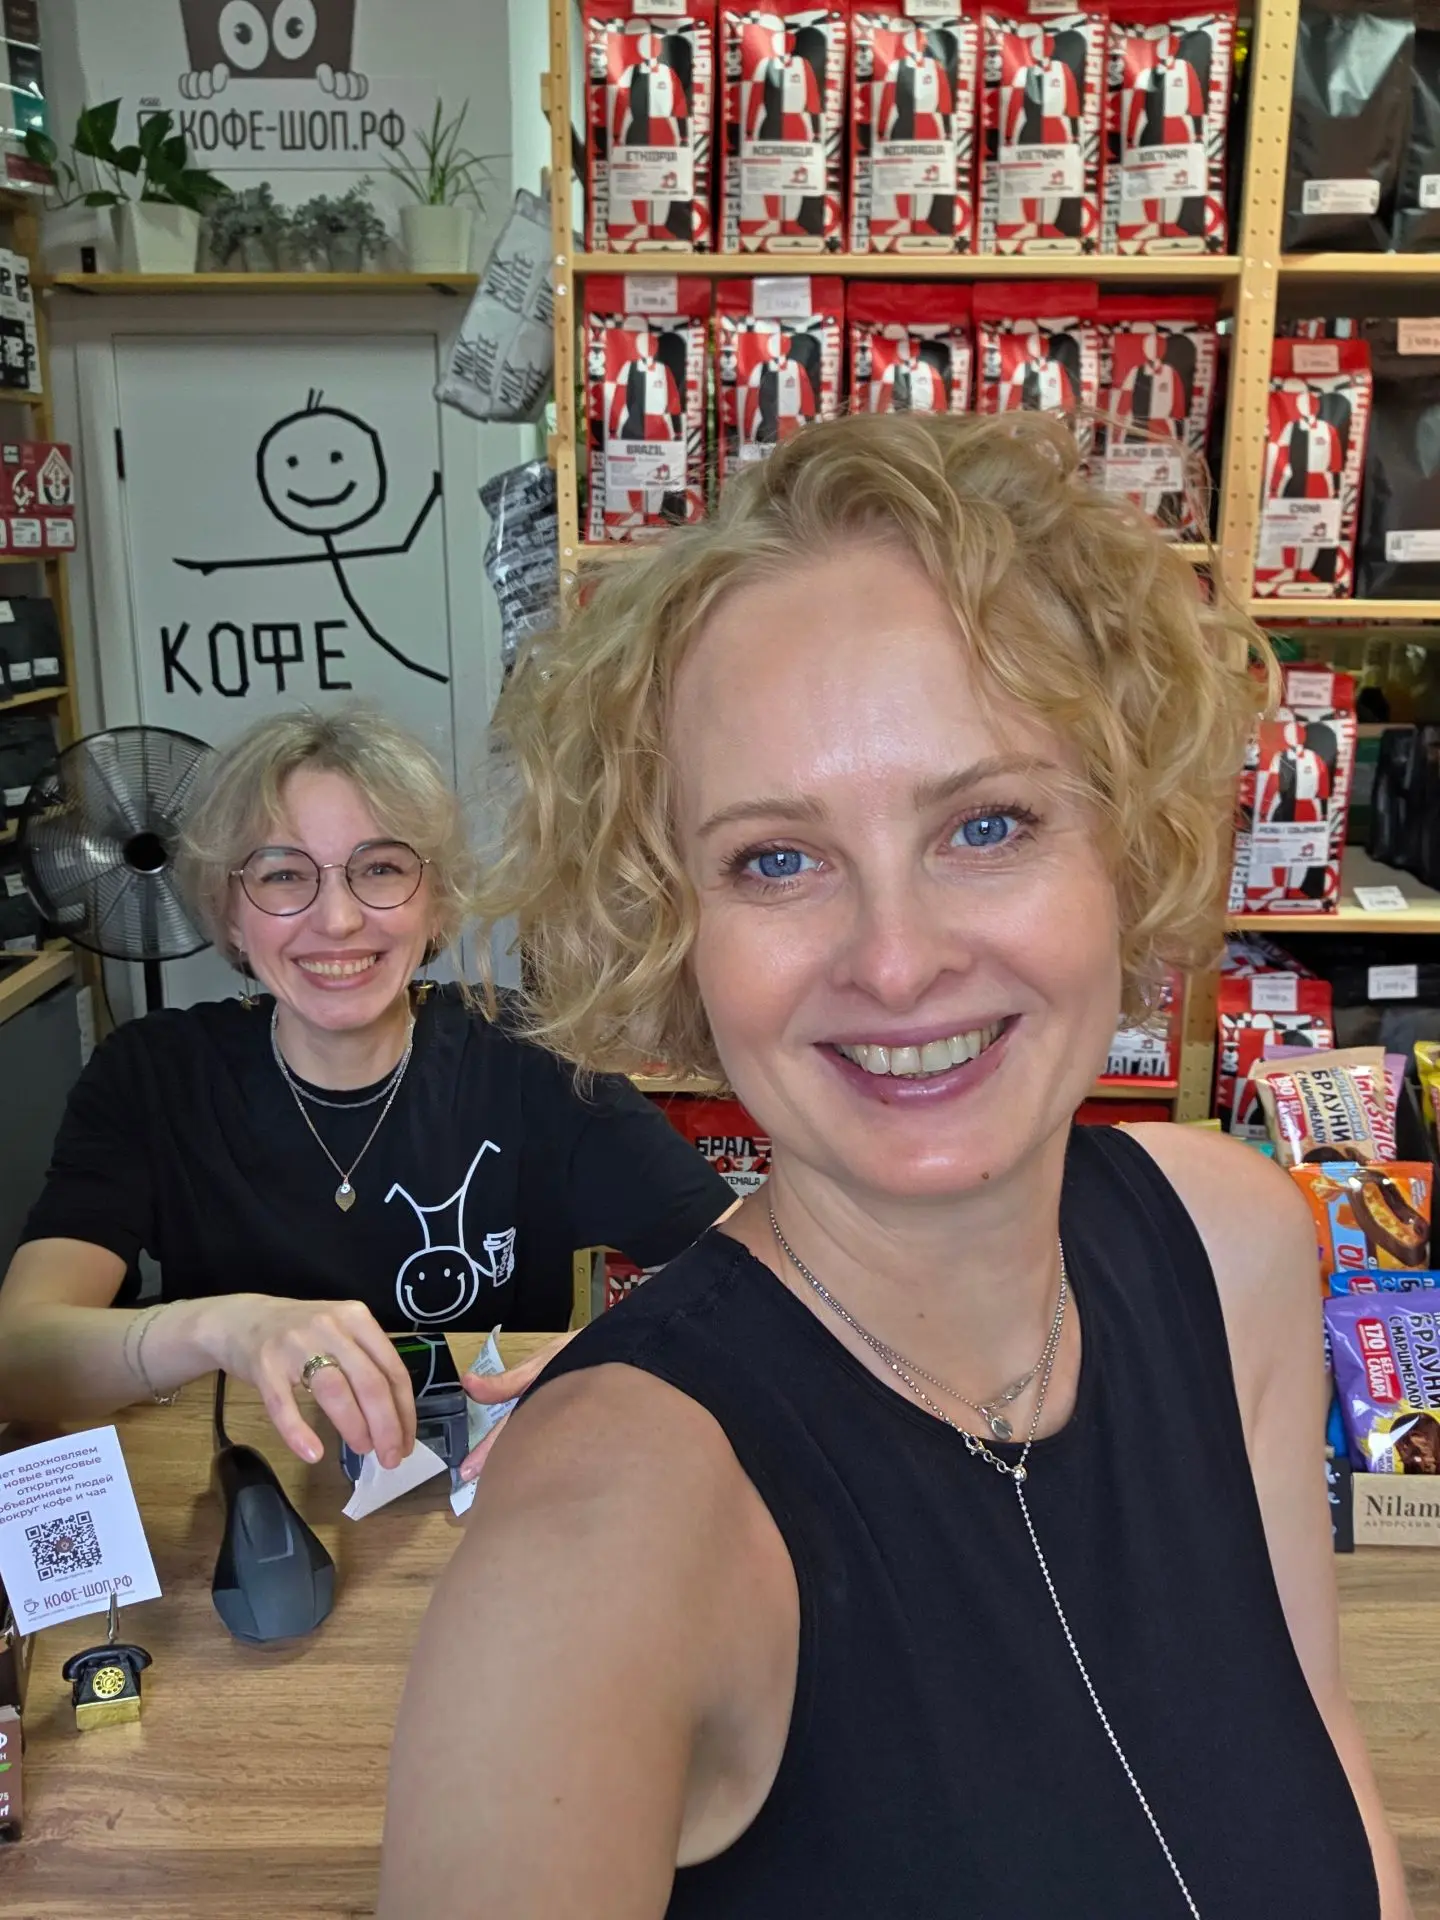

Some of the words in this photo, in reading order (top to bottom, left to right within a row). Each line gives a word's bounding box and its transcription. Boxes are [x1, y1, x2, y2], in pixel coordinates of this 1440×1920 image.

[180, 108, 405, 151] КОФЕ-ШОП.РФ
[485, 252, 514, 305] MILK
[502, 252, 534, 314] COFFEE
[452, 333, 478, 383] MILK
[499, 360, 527, 408] MILK
[626, 443, 666, 457] BRAZIL
[161, 620, 352, 697] КОФЕ
[1105, 1056, 1169, 1077] АГАЛ
[1298, 1077, 1327, 1143] МАРШМЕЛЛОУ
[1311, 1070, 1351, 1142] БРАУНИ
[726, 1176, 761, 1185] TEMALA
[496, 1243, 511, 1278] КОФЕ
[1364, 1323, 1387, 1349] 170
[1366, 1358, 1386, 1398] САХАРА
[1380, 1357, 1394, 1374] БЕЗ
[1393, 1325, 1424, 1409] МАРШМЕЛЛОУ
[1408, 1313, 1440, 1409] БРАУНИ
[4, 1472, 42, 1489] новые
[45, 1456, 102, 1476] вкусовые
[18, 1446, 98, 1473] вдохновляем
[0, 1486, 71, 1514] объединяем
[75, 1474, 113, 1490] людей
[17, 1474, 74, 1496] открытия
[43, 1495, 73, 1510] кофе
[76, 1493, 84, 1501] и
[86, 1487, 107, 1497] чая
[44, 1575, 133, 1610] КОФЕ-ШОП.РФ
